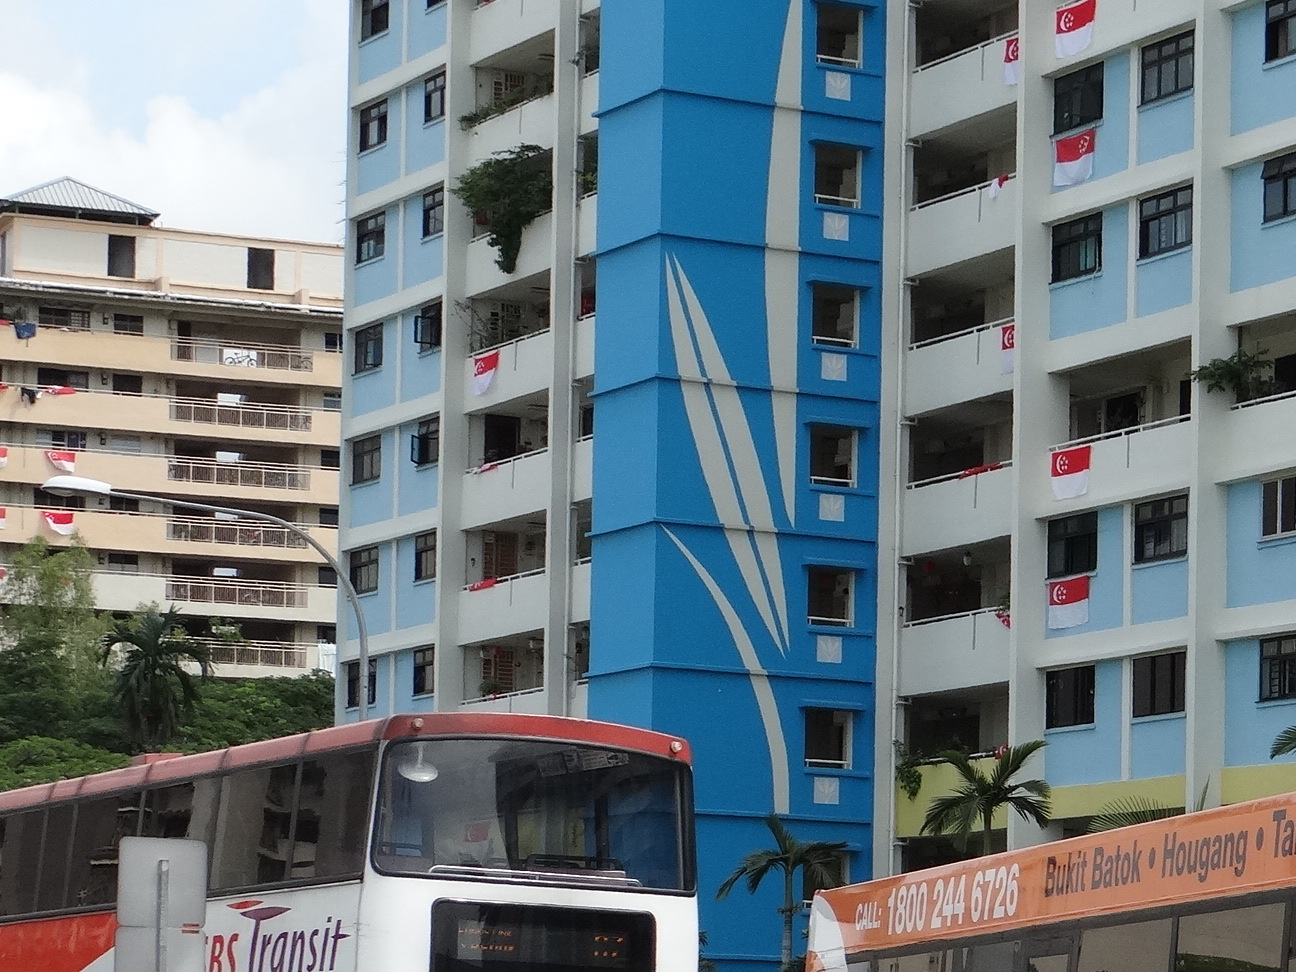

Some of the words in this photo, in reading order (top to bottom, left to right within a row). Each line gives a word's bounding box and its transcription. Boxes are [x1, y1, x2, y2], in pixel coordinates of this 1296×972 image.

[1044, 850, 1087, 898] Bukit
[1091, 839, 1143, 891] Batok
[1161, 830, 1249, 884] Hougang
[855, 901, 881, 931] CALL:
[887, 881, 928, 936] 1800
[930, 874, 967, 929] 244
[971, 863, 1020, 923] 6726
